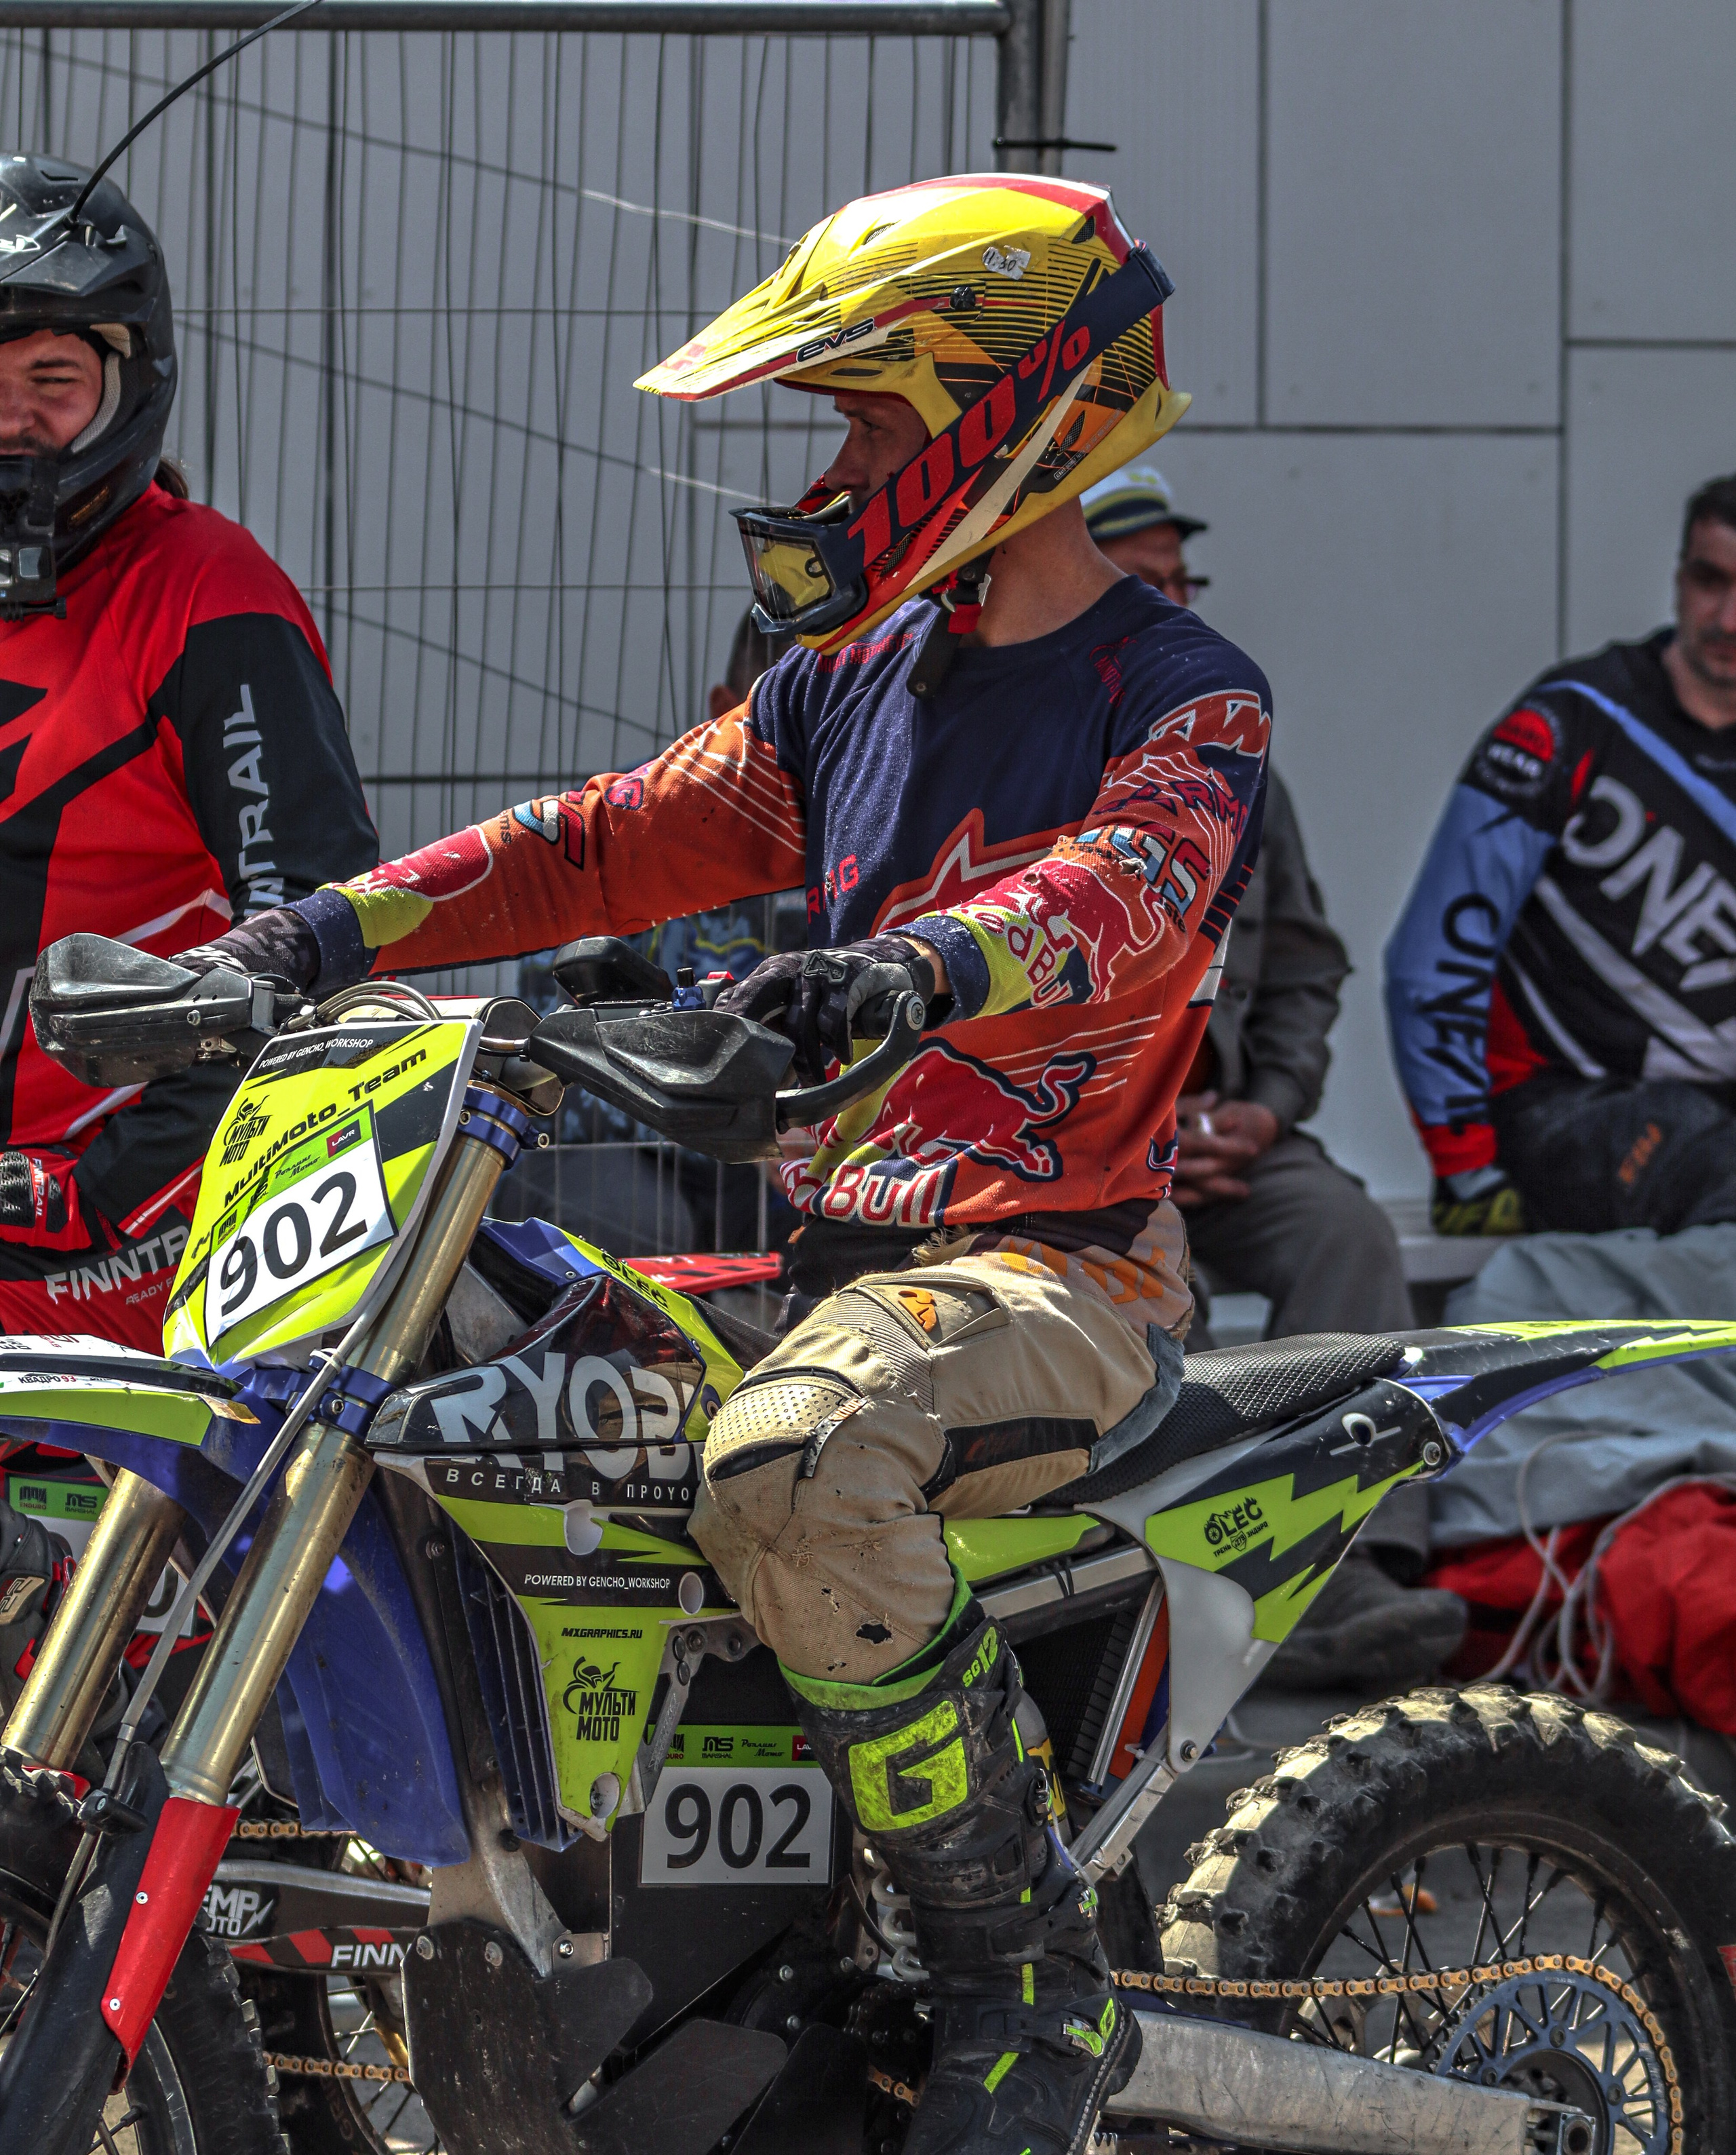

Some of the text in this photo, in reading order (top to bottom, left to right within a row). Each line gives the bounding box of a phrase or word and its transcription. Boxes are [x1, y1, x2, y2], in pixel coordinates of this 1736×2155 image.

[847, 319, 1090, 568] 100%
[222, 684, 285, 917] NTRAIL
[258, 1053, 288, 1069] POWERED
[286, 1049, 298, 1061] BY
[229, 1115, 270, 1146] МУЛЬТИ
[332, 1129, 355, 1146] LAVR
[219, 1140, 250, 1167] МОТО
[822, 1161, 944, 1225] Bull
[220, 1171, 368, 1317] 902
[125, 1283, 163, 1305] READY
[446, 1468, 561, 1494] ВСЕГДА
[591, 1481, 600, 1496] В
[1213, 1544, 1231, 1557] ТРЕНЬ
[1246, 1521, 1268, 1538] ЭНДУРО
[524, 1574, 671, 1589] POWERED BY GENCHO_WORKSHOP
[561, 1627, 643, 1639] MXGRAPHICS.RU
[962, 1626, 998, 1688] SG12
[578, 1691, 636, 1715] МУЛЬТИ
[576, 1716, 620, 1741] МОТО
[665, 1783, 810, 1869] 902
